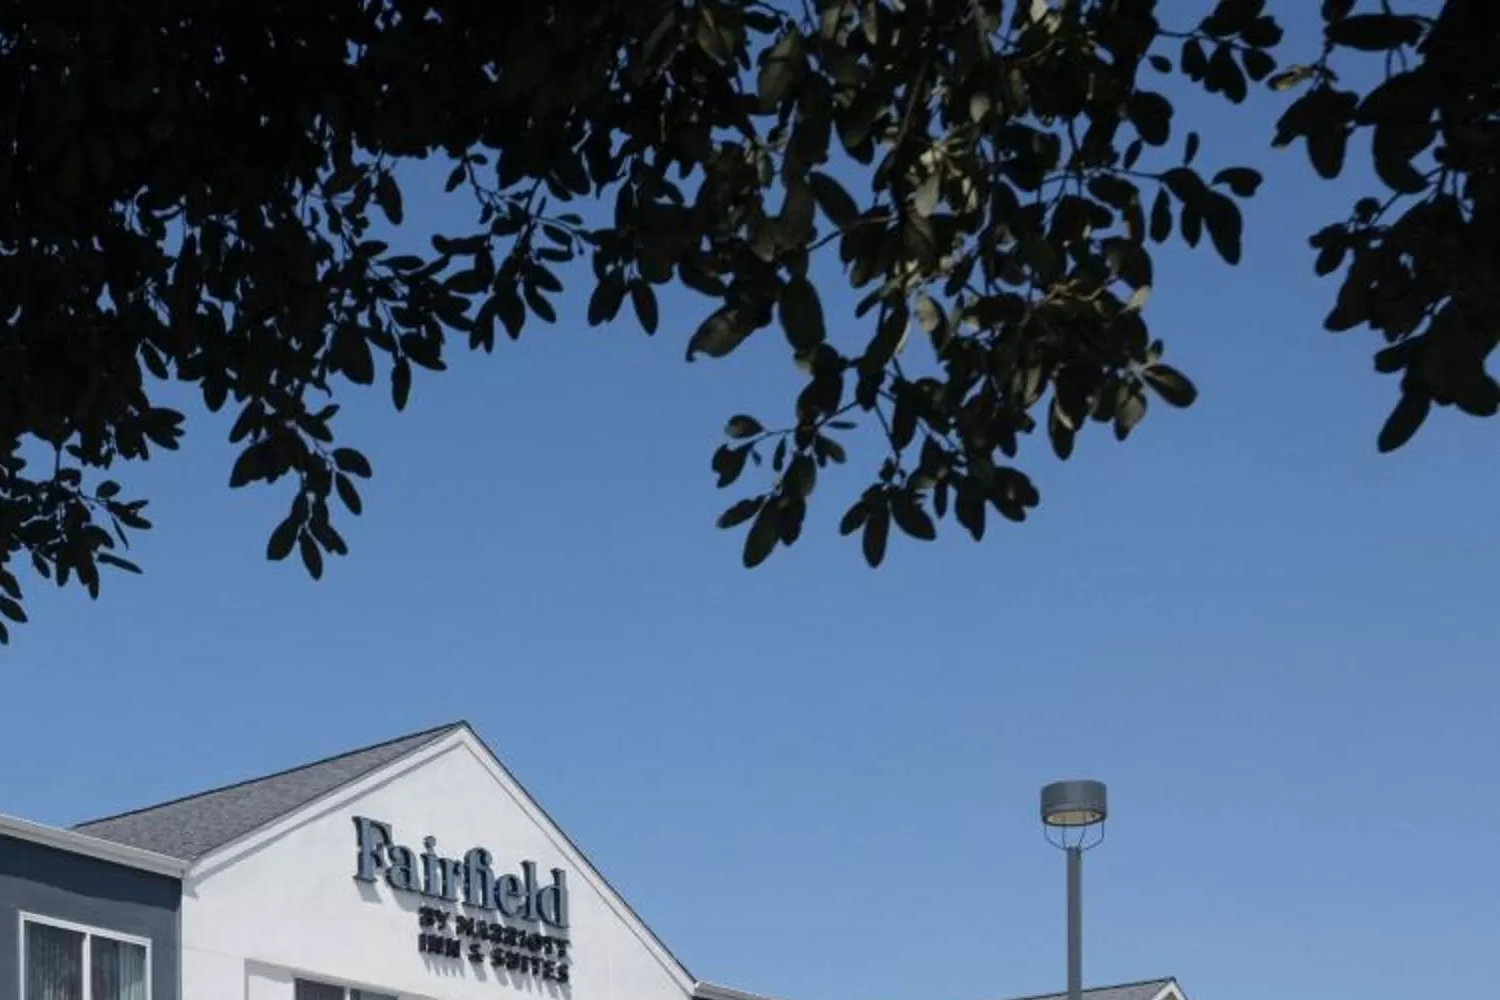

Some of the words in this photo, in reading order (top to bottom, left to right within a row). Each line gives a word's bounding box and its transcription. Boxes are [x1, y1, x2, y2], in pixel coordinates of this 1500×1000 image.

[352, 815, 570, 928] Fairfield
[419, 905, 450, 930] BY
[418, 933, 461, 958] INN
[490, 947, 569, 983] SUITES
